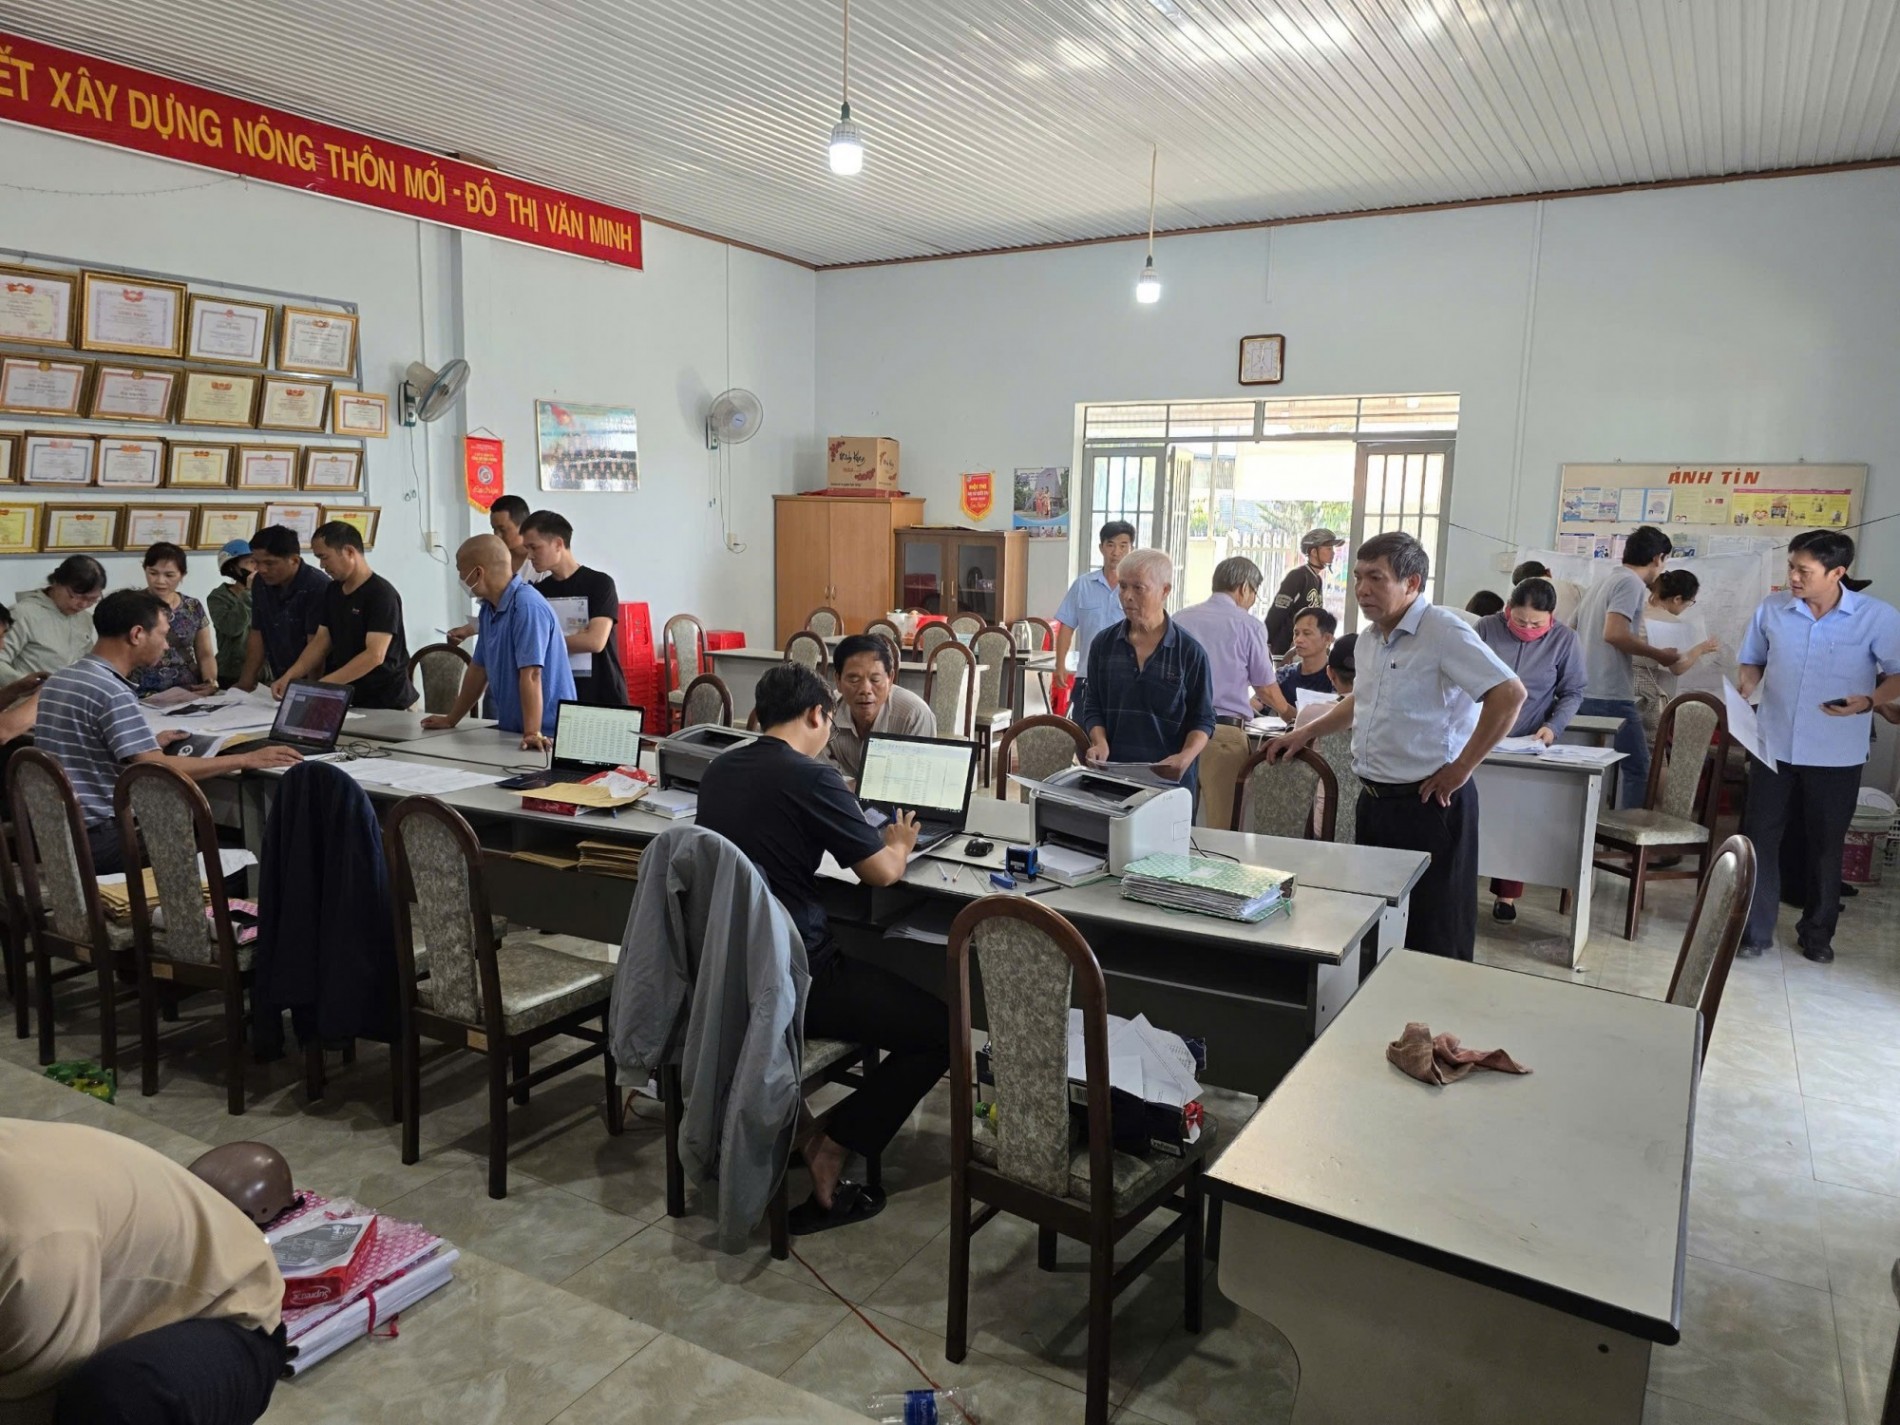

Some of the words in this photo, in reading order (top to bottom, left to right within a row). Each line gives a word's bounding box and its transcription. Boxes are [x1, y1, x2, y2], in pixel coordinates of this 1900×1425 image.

[48, 66, 118, 122] XÂY
[128, 89, 224, 149] DỰNG
[233, 115, 317, 172] NÔNG
[324, 143, 397, 193] THÔN
[403, 160, 447, 206] MỚI
[464, 177, 497, 218] ĐÔ
[505, 192, 539, 233] THỊ
[545, 200, 584, 241] VĂN
[589, 214, 633, 253] MINH
